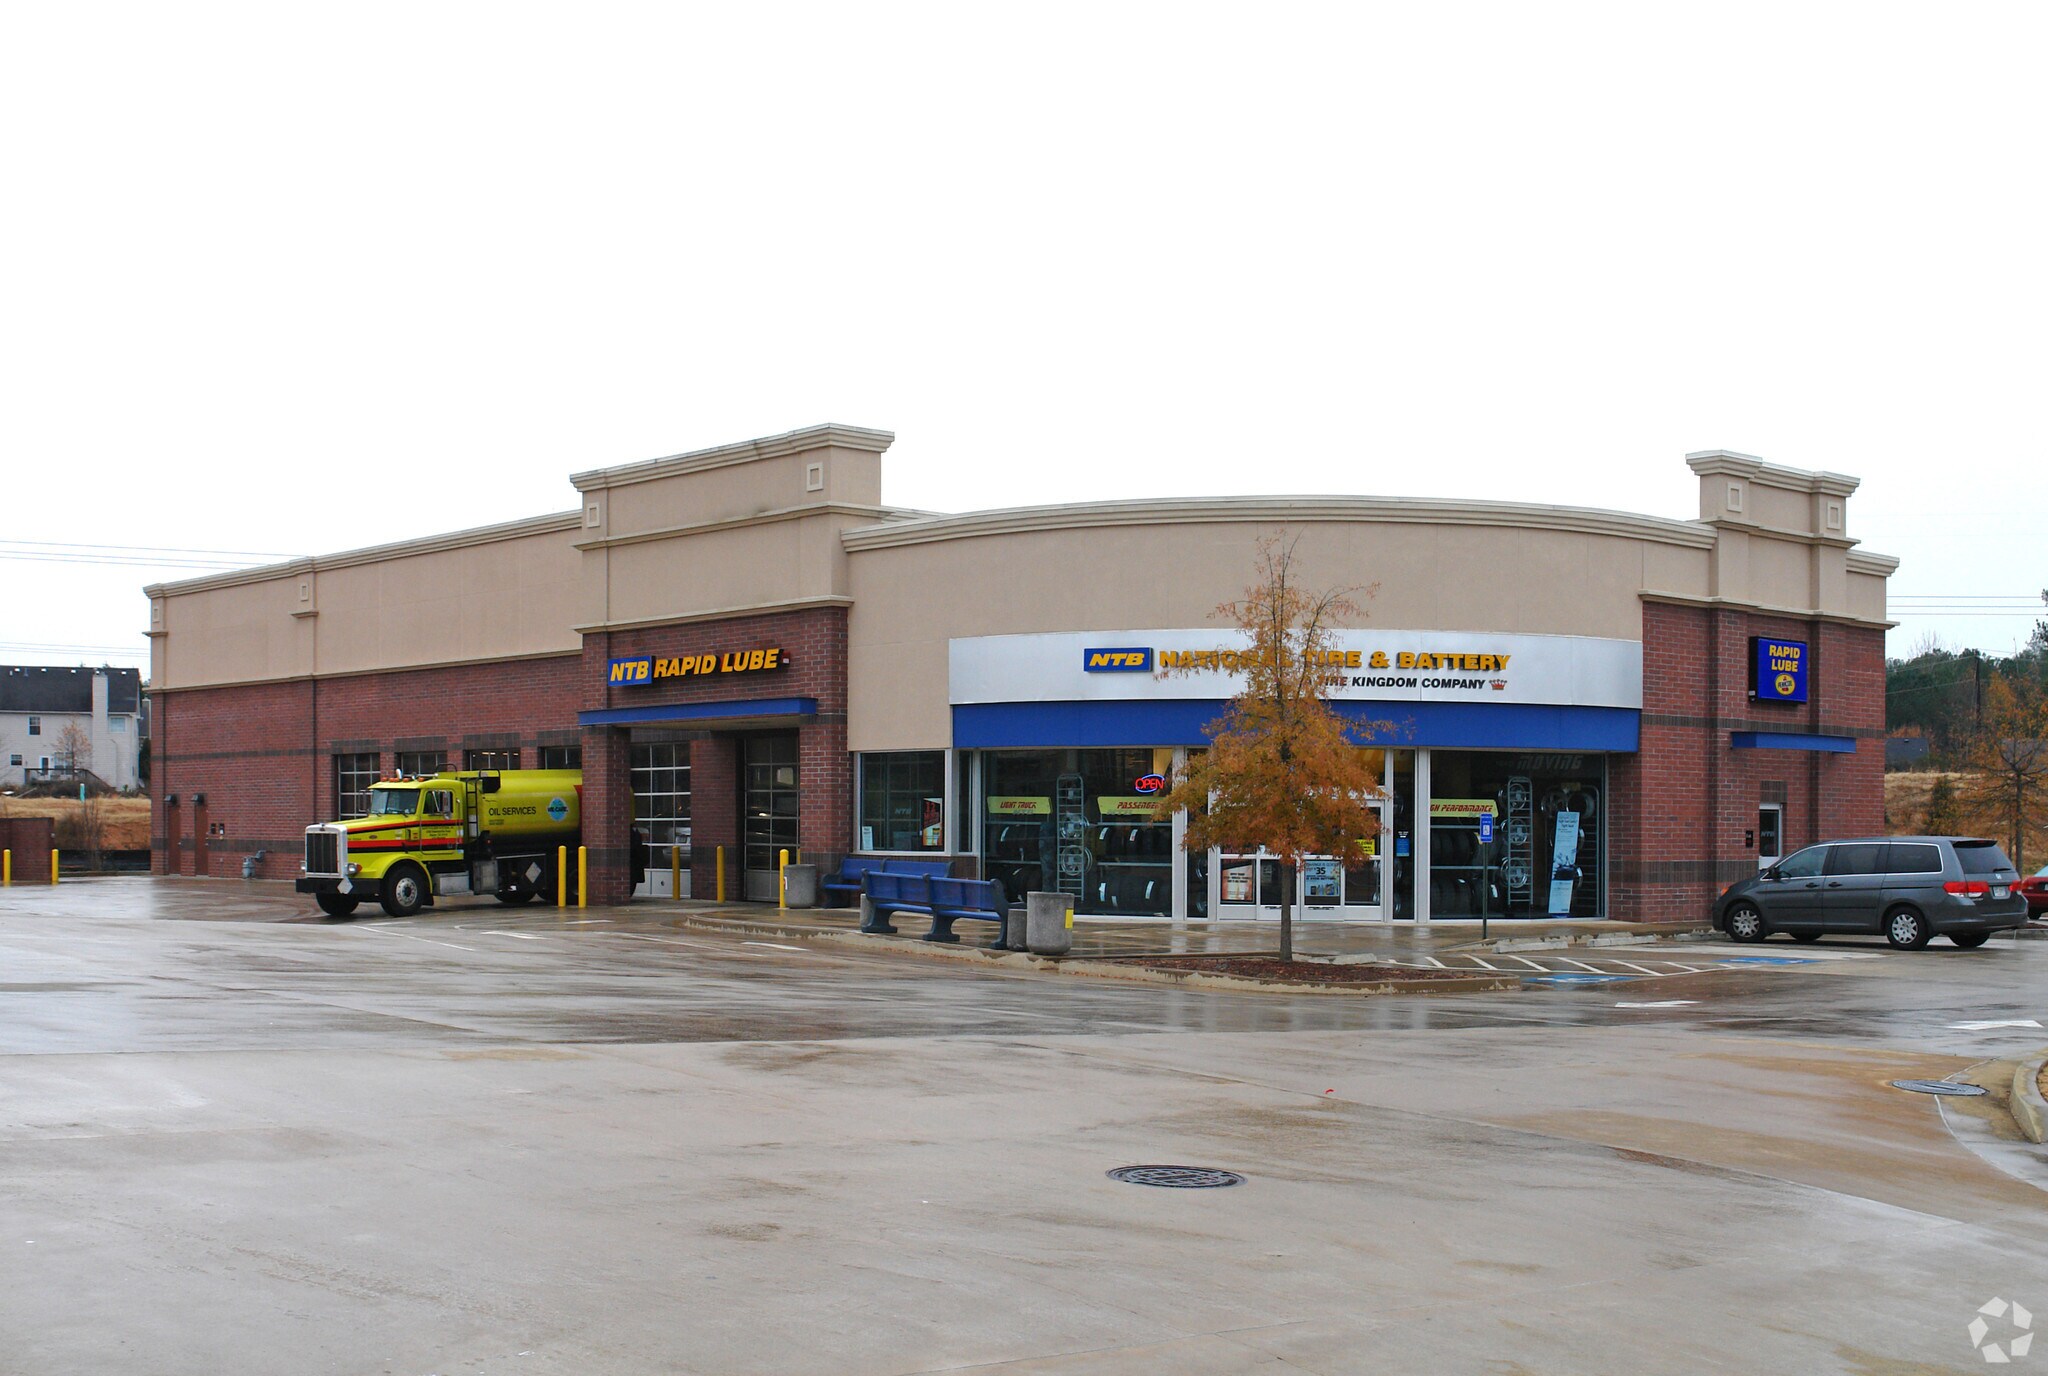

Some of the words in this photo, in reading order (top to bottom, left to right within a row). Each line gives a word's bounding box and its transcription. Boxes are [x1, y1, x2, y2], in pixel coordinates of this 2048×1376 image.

[1769, 644, 1801, 659] RAPID
[610, 660, 649, 682] NTB
[653, 654, 717, 679] RAPID
[720, 648, 780, 673] LUBE
[1089, 653, 1145, 666] NTB
[1371, 651, 1390, 669] &
[1399, 651, 1511, 671] BATTERY
[1771, 658, 1799, 672] LUBE
[1352, 676, 1418, 688] KINGDOM
[1421, 677, 1486, 689] COMPANY
[1134, 777, 1165, 790] OPEN
[488, 807, 501, 816] OIL
[502, 806, 537, 816] SERVICES
[1018, 801, 1037, 809] TRUCK
[1441, 804, 1493, 812] PERFORMANCE
